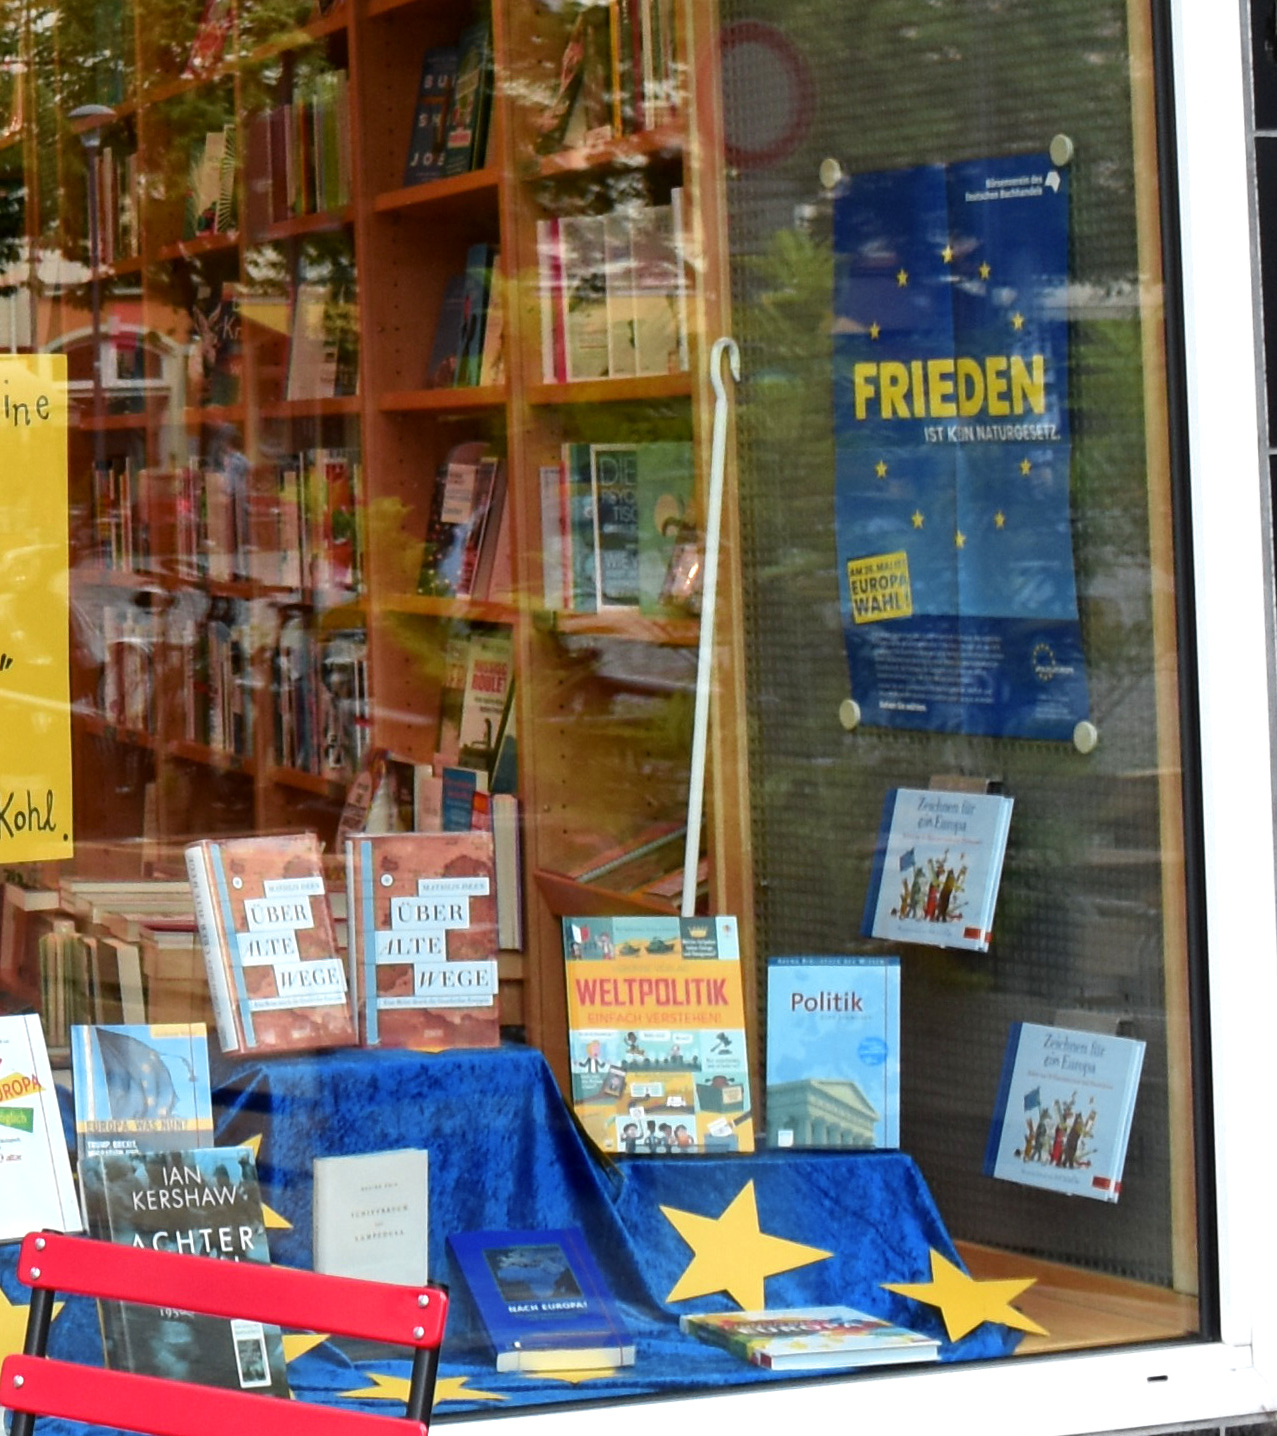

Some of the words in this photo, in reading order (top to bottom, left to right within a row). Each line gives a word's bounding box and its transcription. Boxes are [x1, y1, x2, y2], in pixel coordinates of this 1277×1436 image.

[854, 354, 1045, 420] FRIEDEN
[924, 426, 944, 443] IST
[976, 424, 1061, 442] NATURGESETZ.
[916, 796, 959, 815] Zeichnen
[960, 801, 977, 816] für
[934, 814, 968, 834] Europa
[250, 902, 309, 925] ÜBER
[397, 902, 464, 923] ÜBER
[246, 936, 295, 958] ALTE
[380, 937, 442, 957] ALTE
[280, 967, 340, 990] WEGE
[419, 969, 489, 988] WEGE
[575, 978, 729, 1006] WELTPOLITIK
[791, 991, 862, 1012] Politik
[1043, 1033, 1089, 1055] Zeichnen
[1090, 1042, 1106, 1057] für
[1061, 1057, 1097, 1077] Europa
[162, 1165, 202, 1187] IAN
[132, 1186, 238, 1212] KERSHAW
[508, 1304, 539, 1314] NACH
[541, 1301, 588, 1312] EUROPA!
